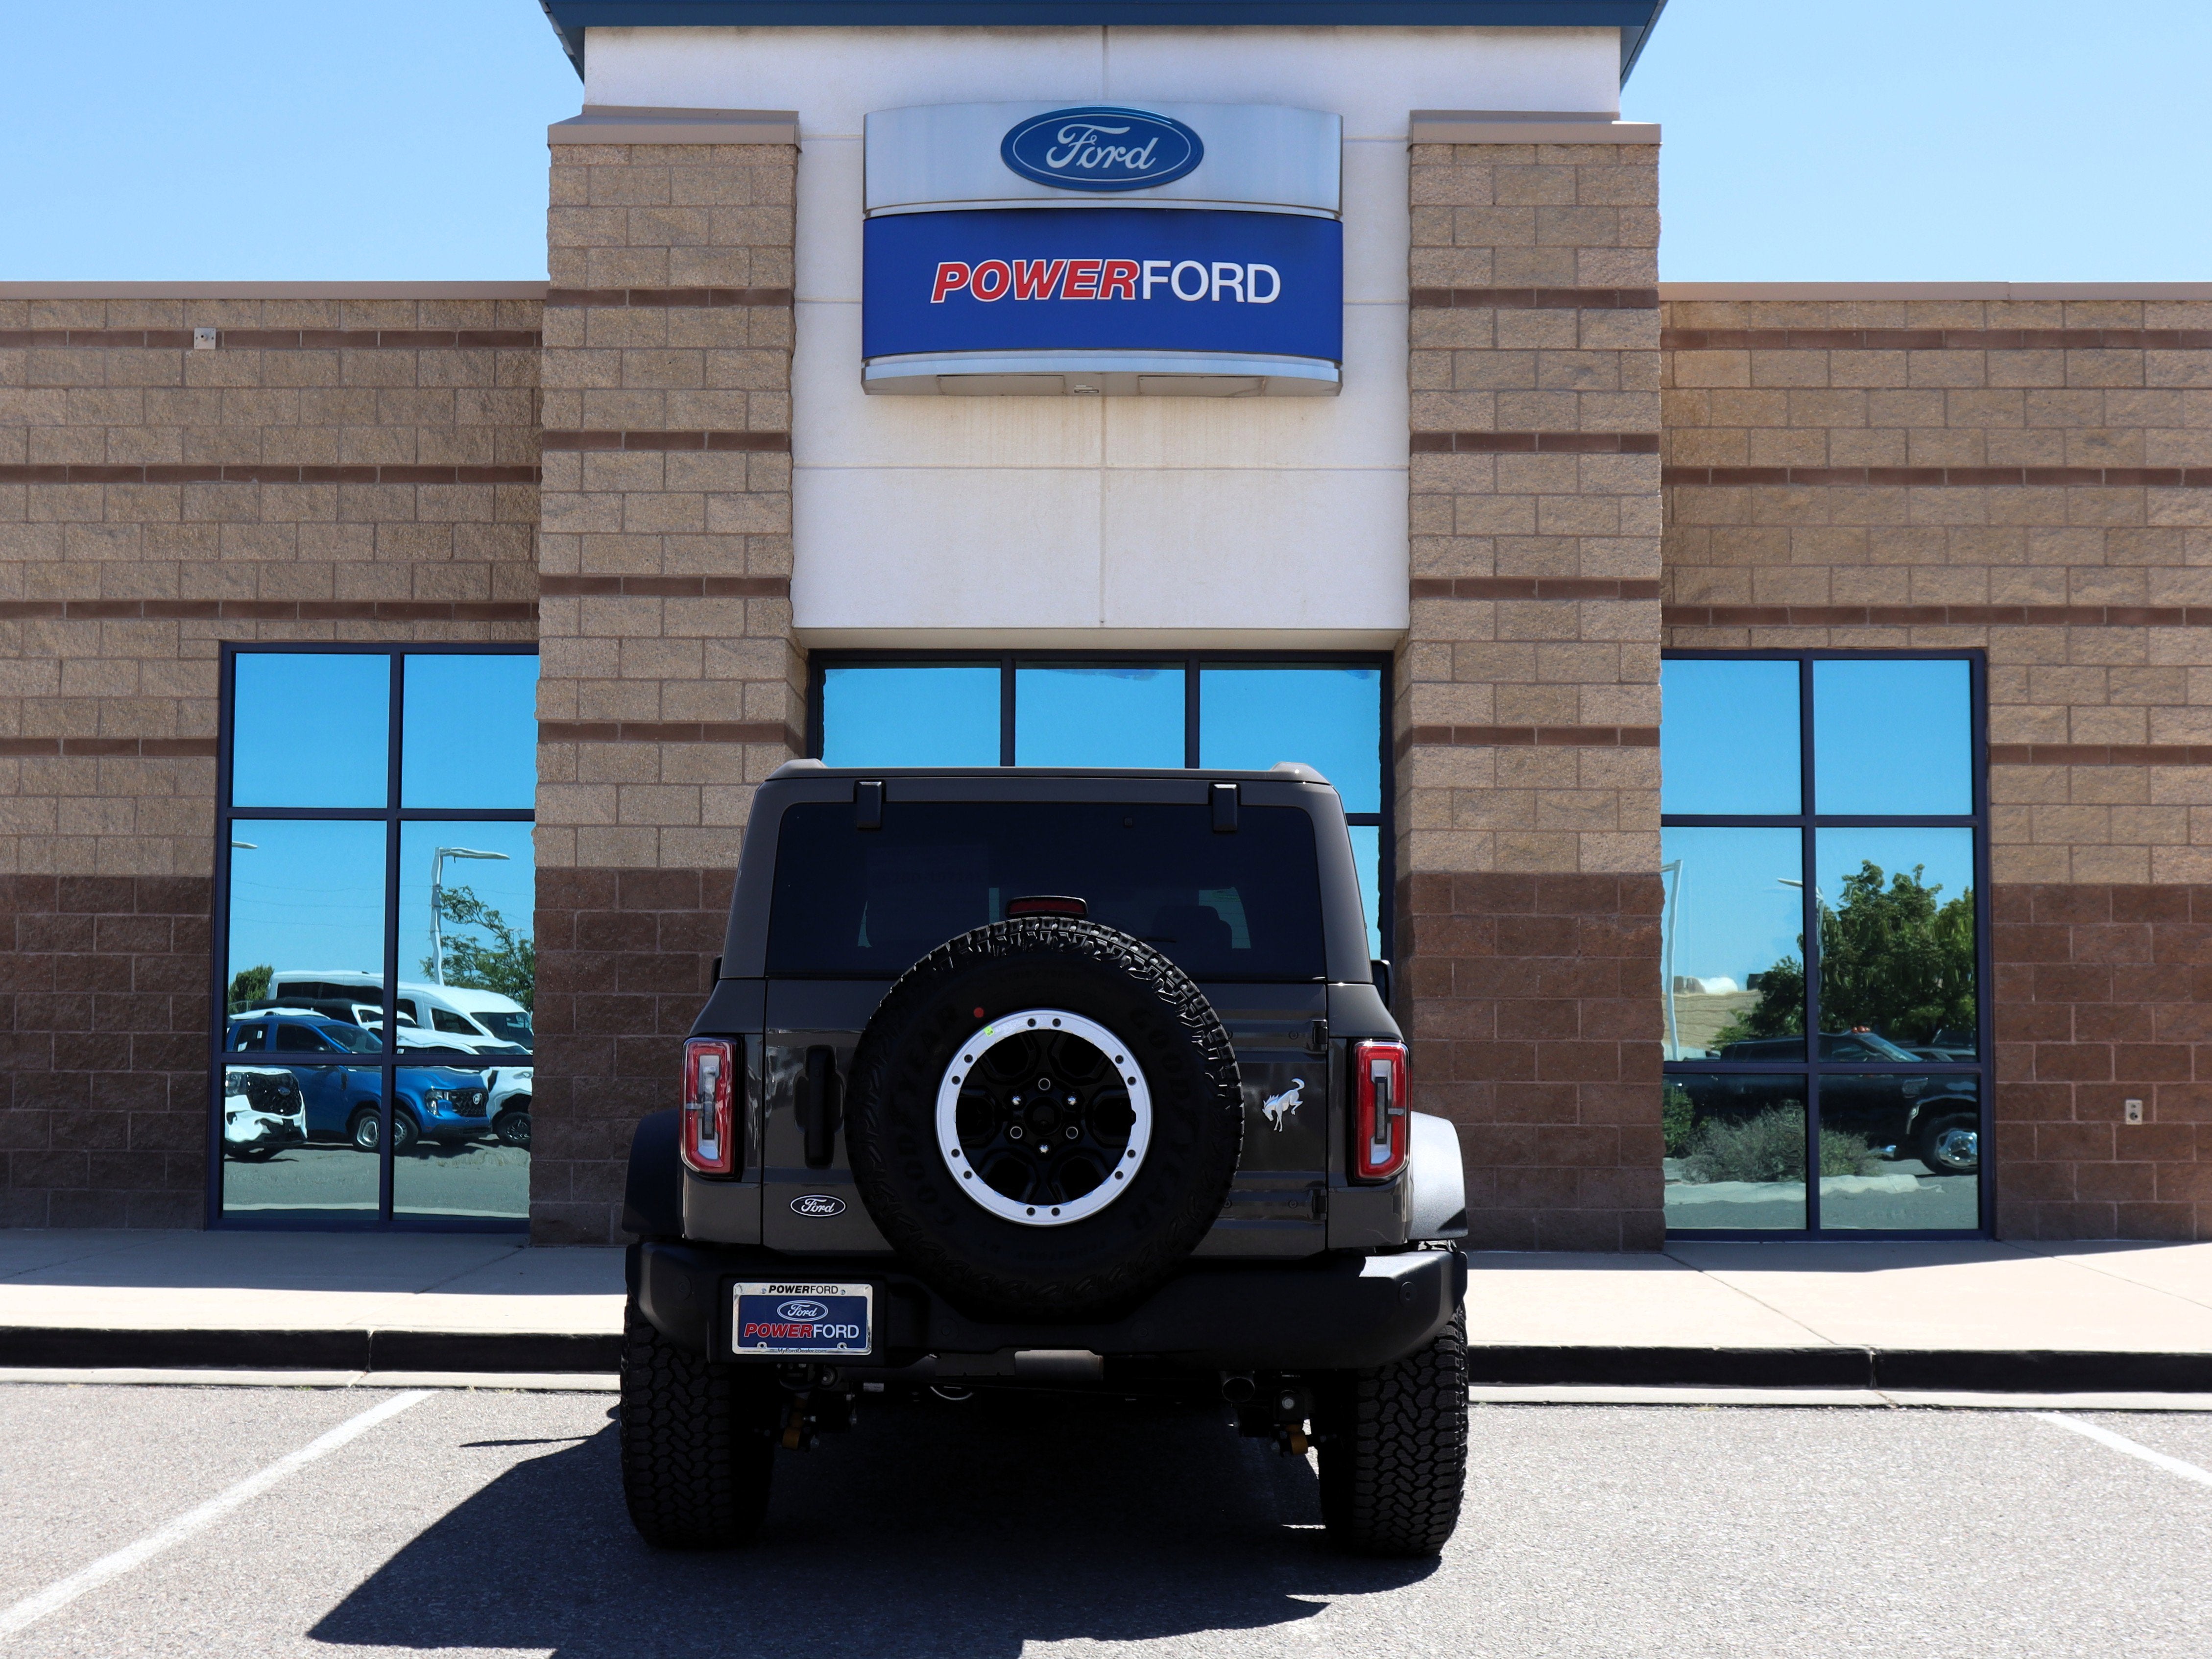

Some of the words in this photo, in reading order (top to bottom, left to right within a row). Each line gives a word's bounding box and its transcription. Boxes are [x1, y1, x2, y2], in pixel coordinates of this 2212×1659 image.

[1046, 123, 1159, 170] Ford
[801, 1198, 835, 1213] Ford
[787, 1303, 817, 1317] Ford
